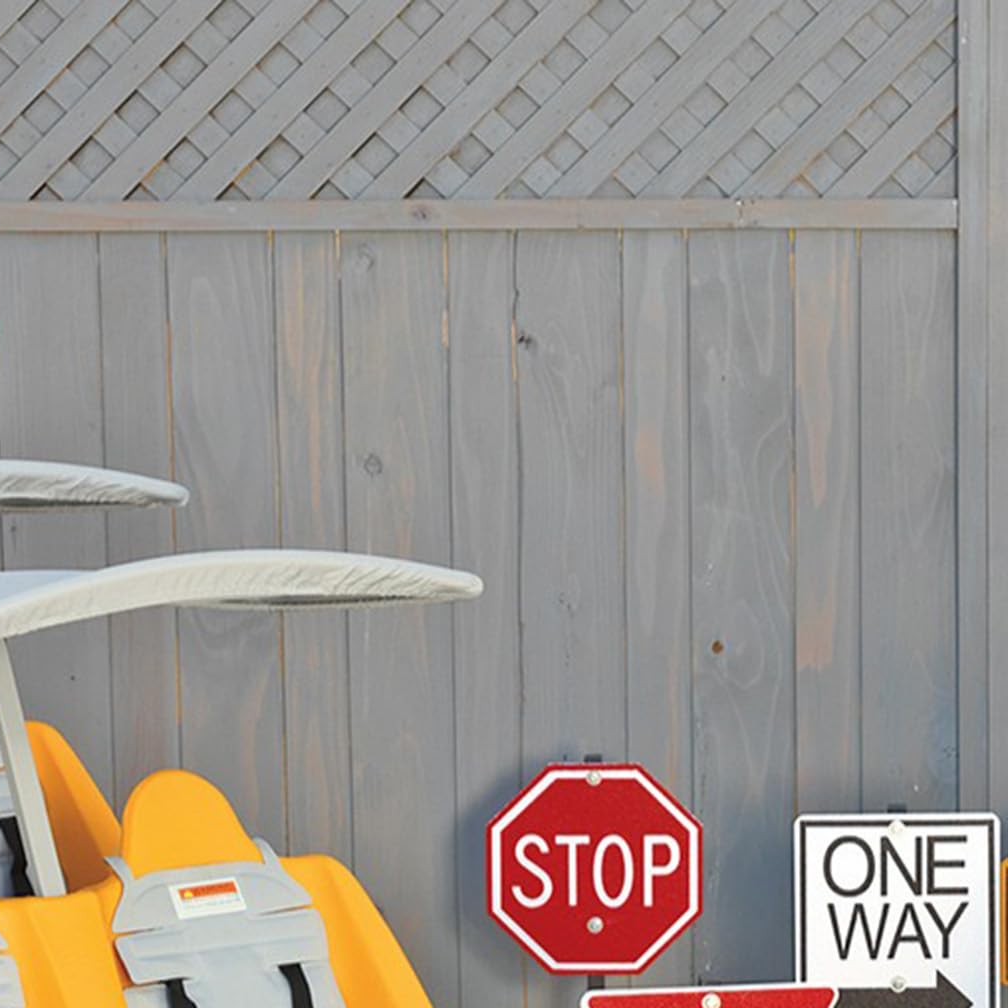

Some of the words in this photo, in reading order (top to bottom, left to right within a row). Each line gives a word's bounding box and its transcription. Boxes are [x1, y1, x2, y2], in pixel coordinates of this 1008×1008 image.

[511, 834, 681, 908] STOP
[823, 835, 969, 897] ONE
[827, 902, 969, 961] WAY
